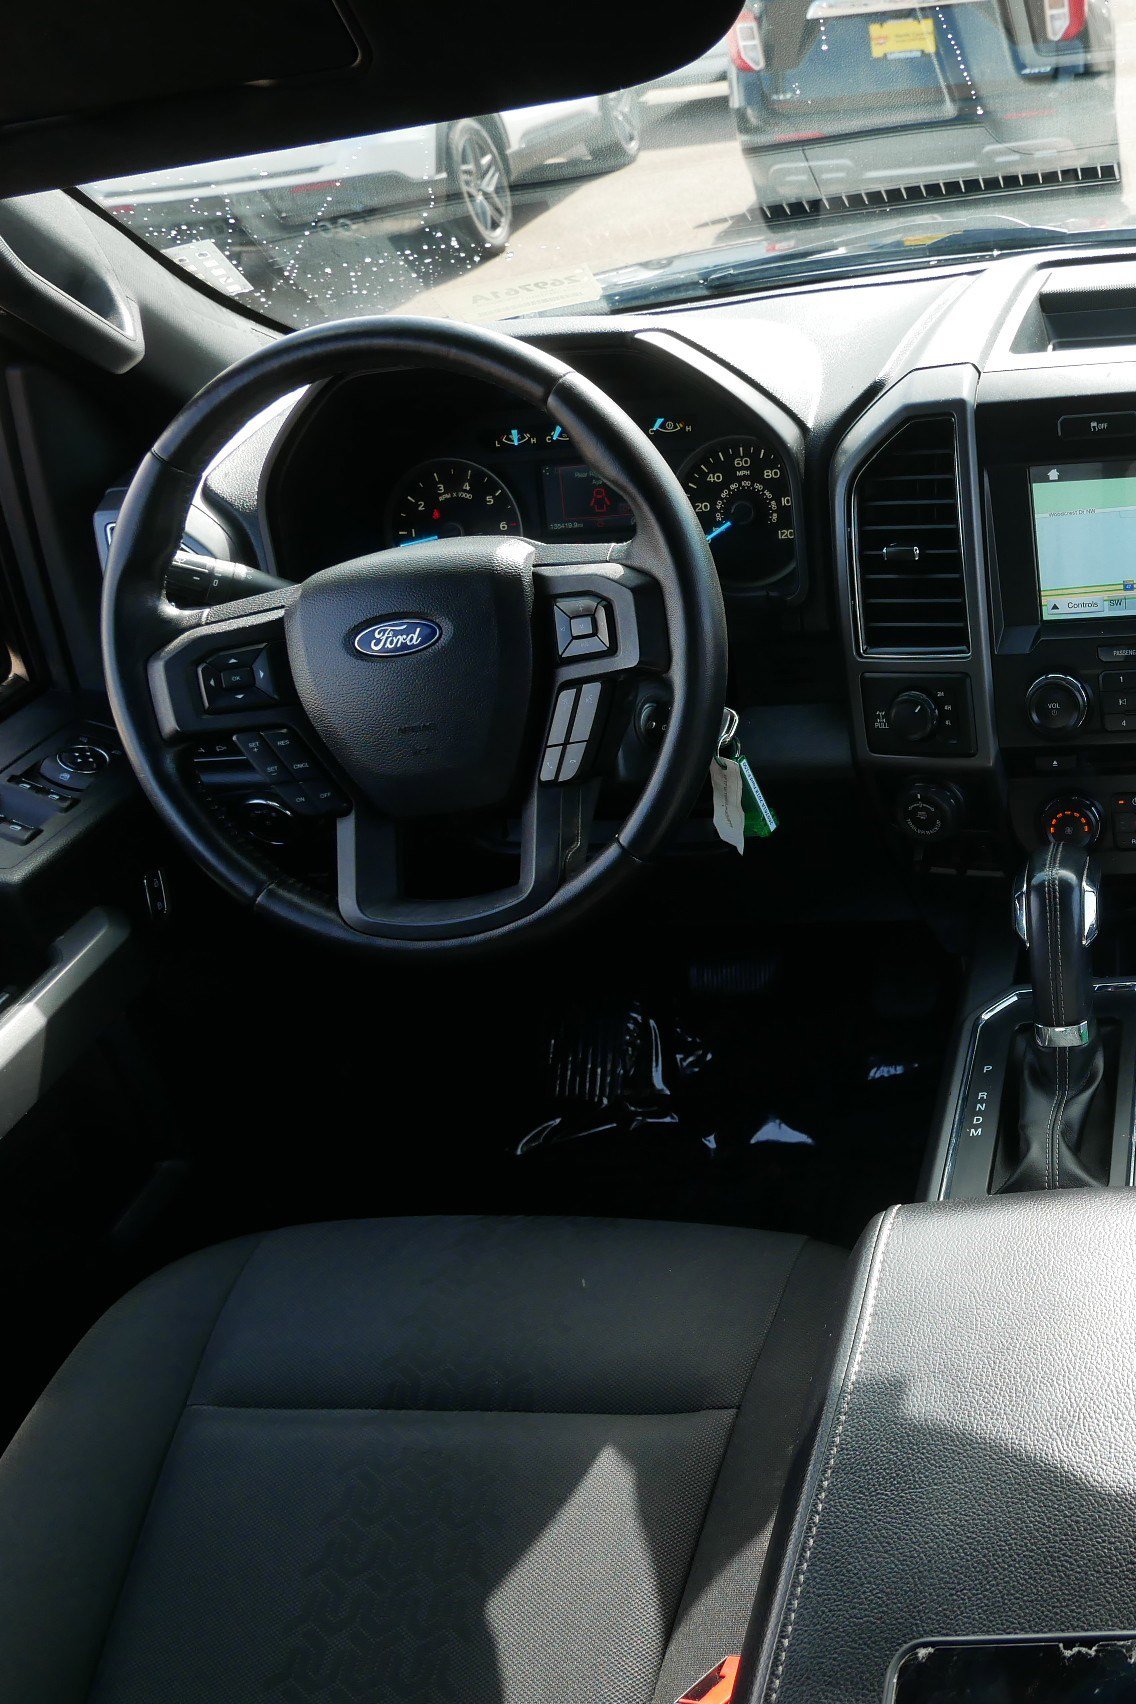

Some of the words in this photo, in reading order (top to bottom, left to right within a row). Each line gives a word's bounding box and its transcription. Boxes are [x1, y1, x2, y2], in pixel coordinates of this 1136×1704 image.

[734, 458, 750, 467] 60
[707, 473, 723, 482] 40
[764, 469, 780, 478] 80
[437, 484, 444, 493] 3
[462, 482, 470, 491] 4
[438, 493, 451, 501] RPM
[486, 496, 494, 505] 5
[418, 501, 425, 510] 2
[695, 503, 710, 512] 20
[500, 522, 508, 530] 6
[778, 530, 794, 539] 120
[1068, 601, 1098, 609] Controls
[370, 625, 422, 650] Ford
[983, 1065, 992, 1073] P
[976, 1103, 986, 1111] N
[973, 1116, 983, 1124] D
[970, 1128, 982, 1136] M
